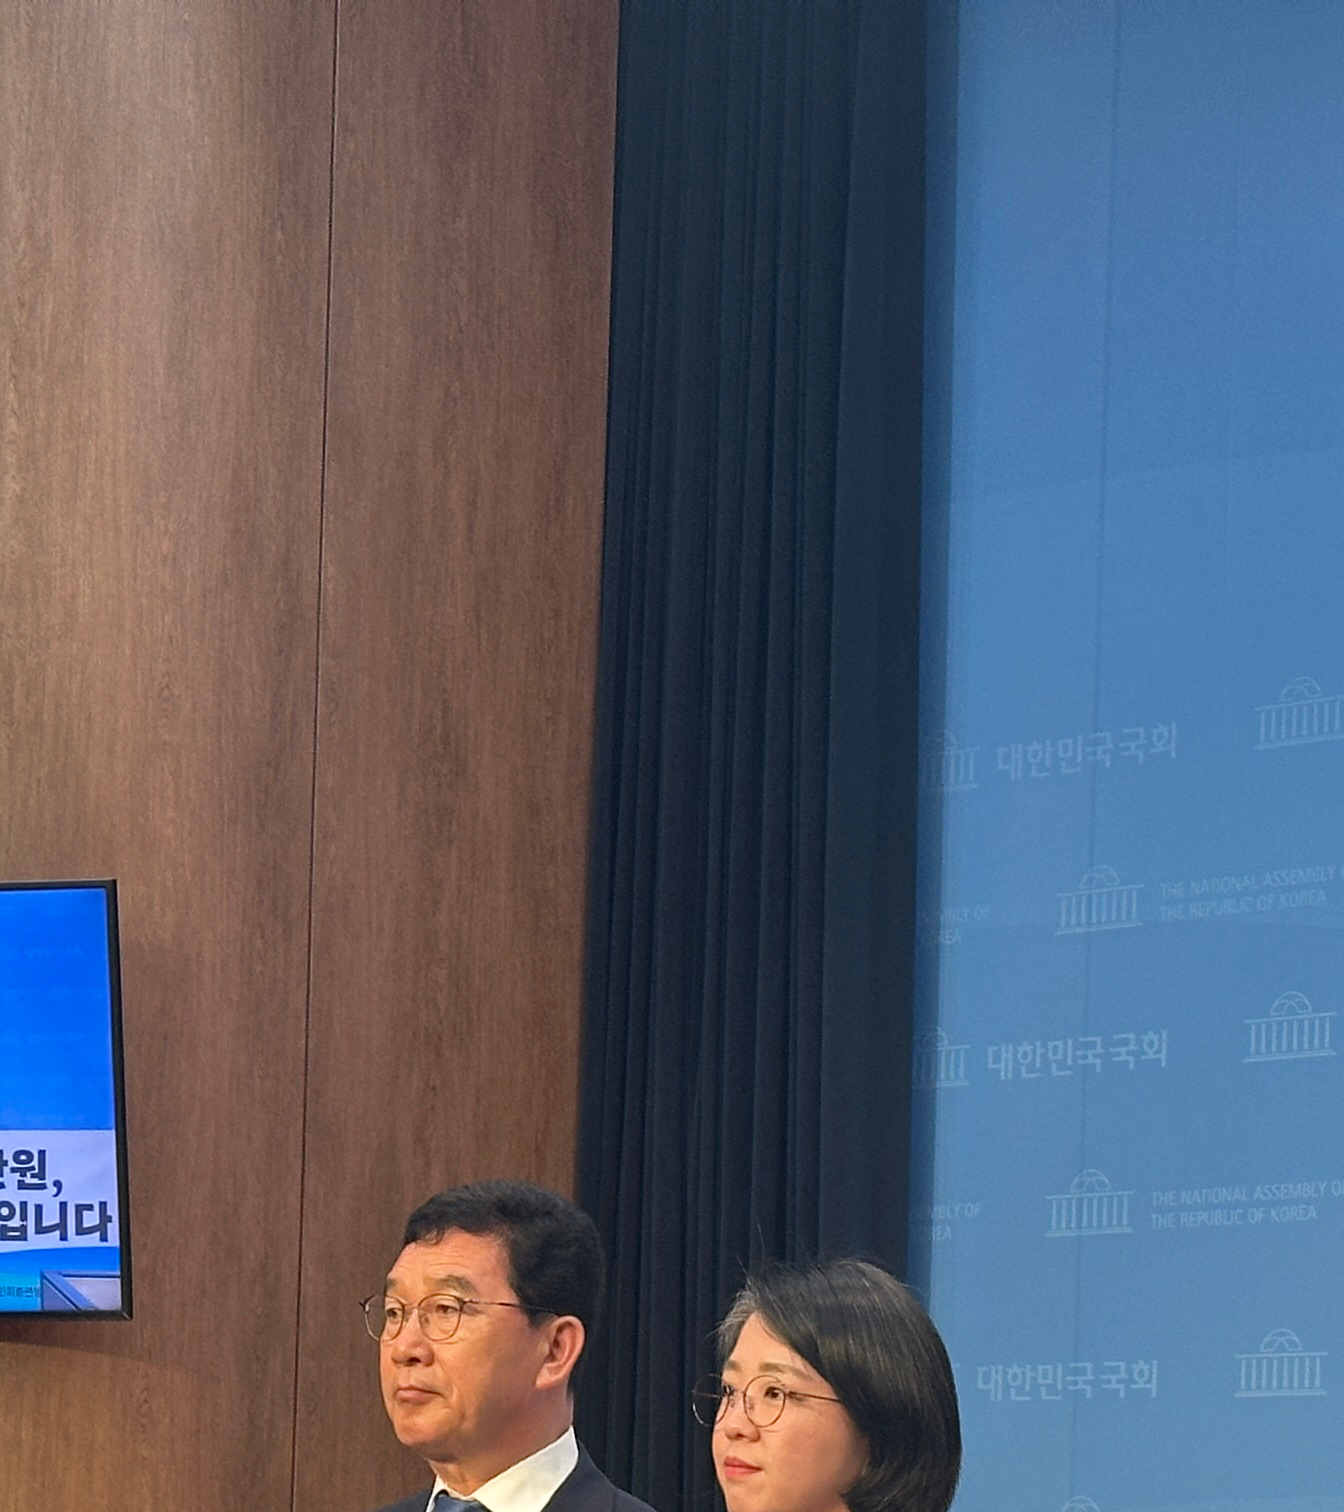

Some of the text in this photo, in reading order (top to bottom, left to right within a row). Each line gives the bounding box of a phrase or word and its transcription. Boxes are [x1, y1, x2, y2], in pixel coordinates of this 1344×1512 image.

[996, 721, 1177, 780] 대한민국국회
[988, 1029, 1167, 1080] 대한민국국회
[1151, 1191, 1176, 1206] THE
[1181, 1187, 1246, 1205] NATIONAL
[1252, 1181, 1327, 1201] ASSEMBLY
[1151, 1204, 1317, 1229] THE REPUBLIC OF KOREA
[976, 1360, 1159, 1400] 대한민국국회
